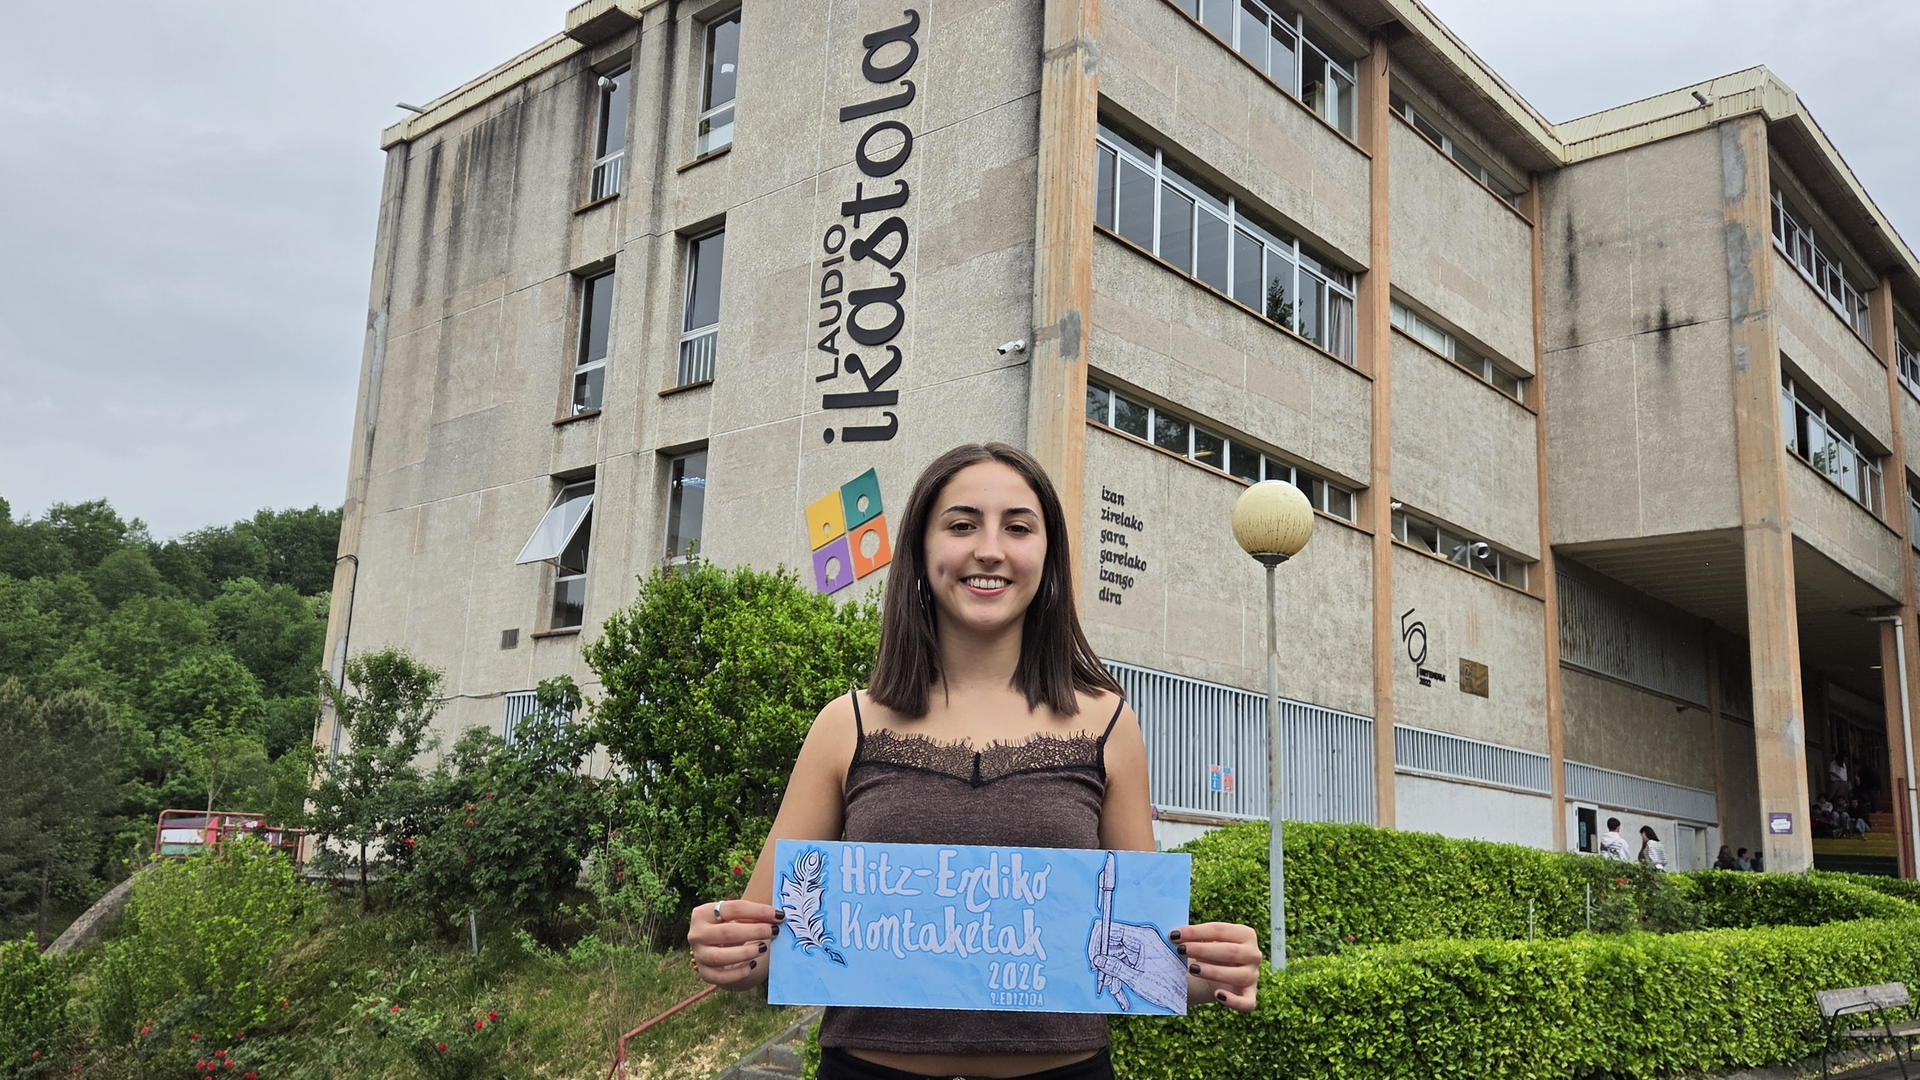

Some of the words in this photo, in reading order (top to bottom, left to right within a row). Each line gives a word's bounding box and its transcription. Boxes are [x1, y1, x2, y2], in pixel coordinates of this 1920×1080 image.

[823, 8, 921, 445] ikastola
[816, 225, 847, 383] LAUDIO
[1101, 485, 1125, 507] izan
[1100, 506, 1144, 532] zirelako
[1099, 528, 1129, 549] gara,
[1099, 548, 1147, 572] garelako
[1099, 565, 1134, 590] izango
[1098, 586, 1122, 606] dira
[839, 845, 1052, 913] Hitz-Erdiko
[840, 901, 1048, 961] Kontaketak
[988, 961, 1047, 991] 2026
[990, 992, 1045, 1006] 9.EDIZIOA
